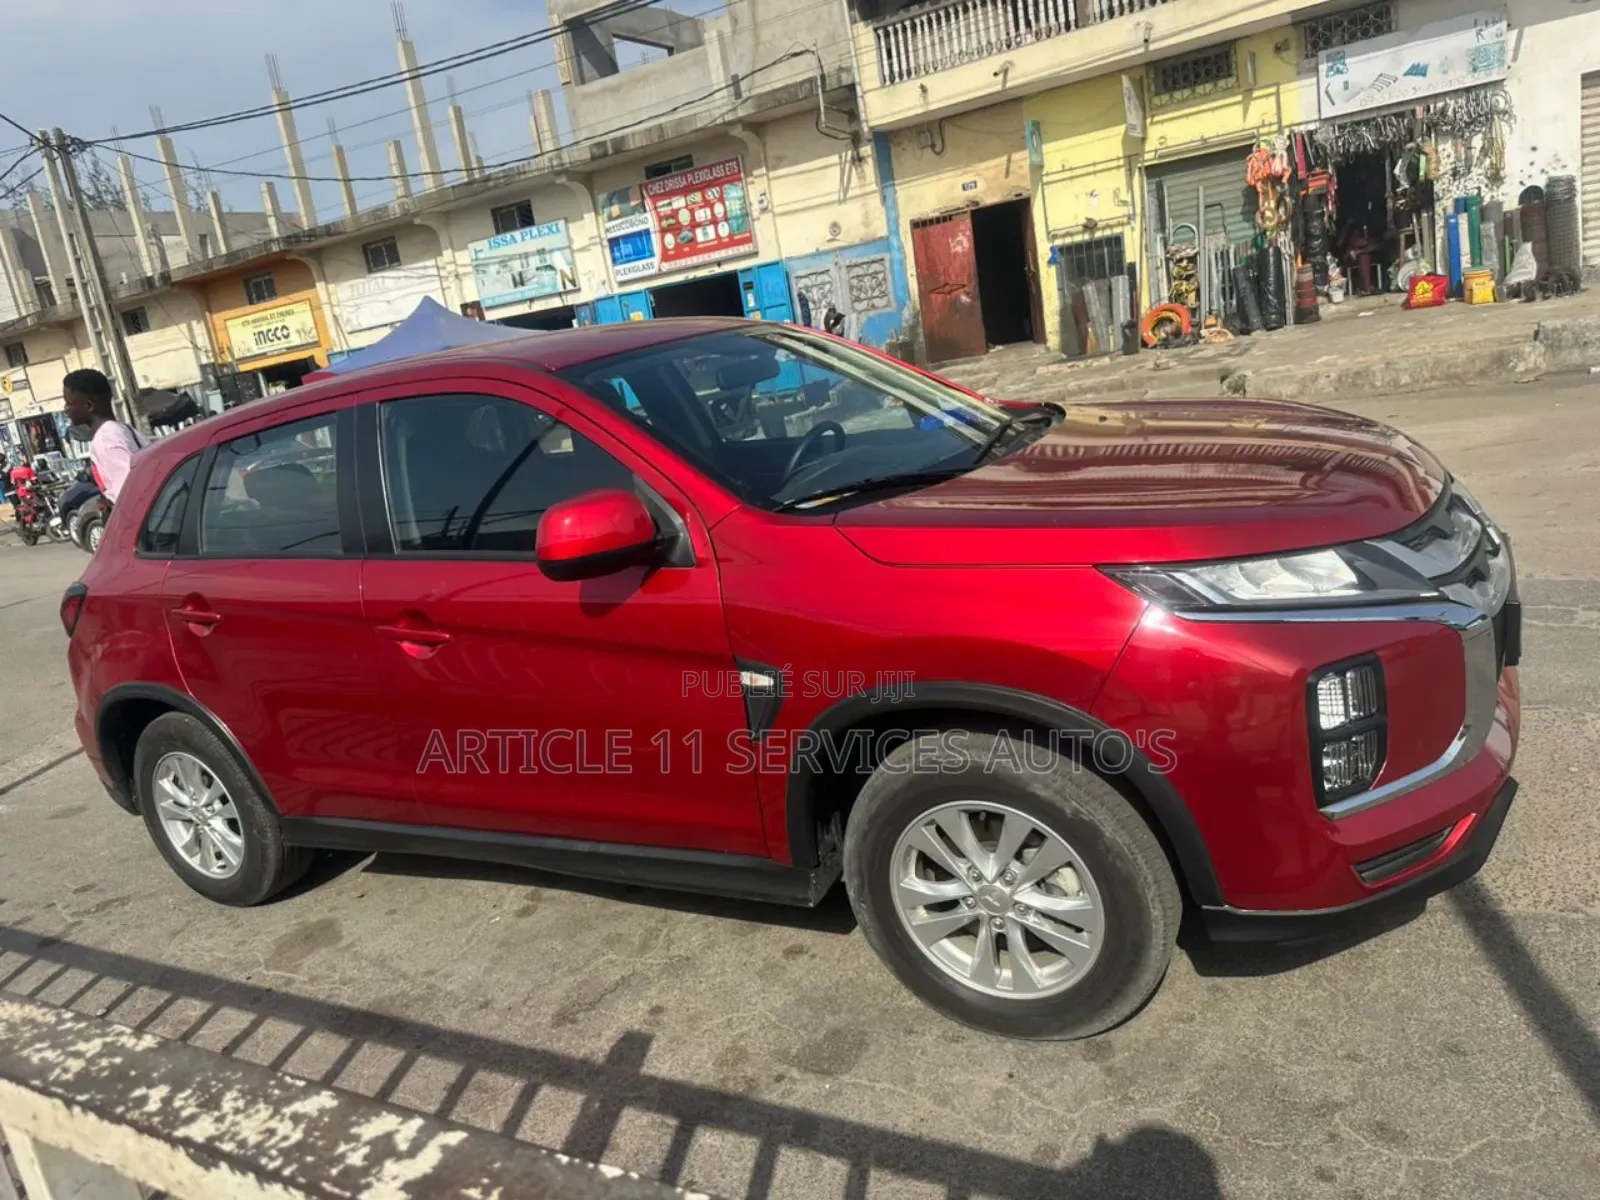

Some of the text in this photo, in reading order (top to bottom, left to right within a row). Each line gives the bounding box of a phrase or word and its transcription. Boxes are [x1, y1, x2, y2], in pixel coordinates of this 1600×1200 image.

[648, 180, 665, 196] CHEZ
[687, 164, 724, 186] PLEXIGLASS
[488, 222, 560, 250] ISSA PLEXI
[615, 261, 655, 276] PLEXIGLASS
